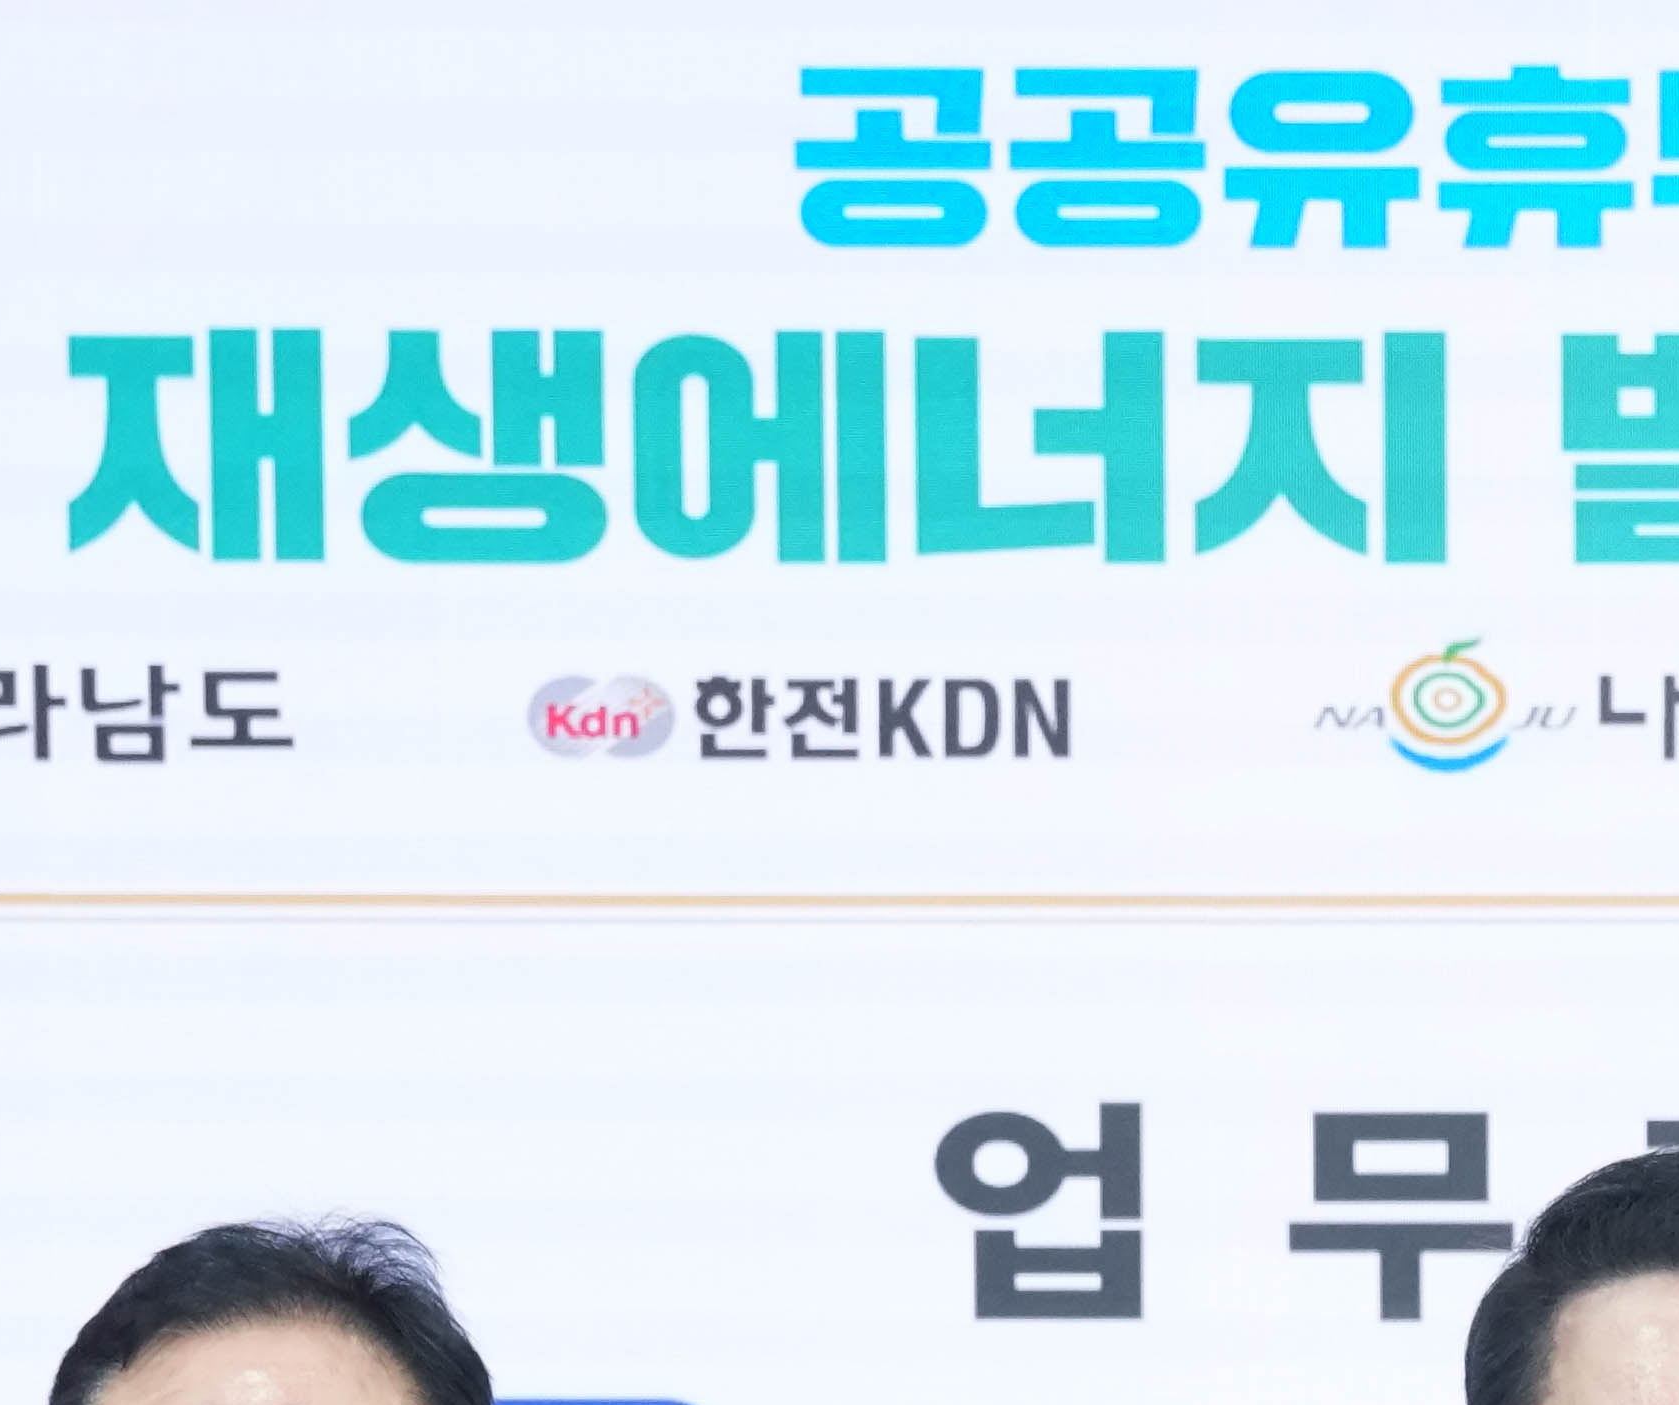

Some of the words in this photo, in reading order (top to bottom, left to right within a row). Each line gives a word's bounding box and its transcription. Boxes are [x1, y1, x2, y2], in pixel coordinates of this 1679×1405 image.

[68, 328, 1447, 564] 재생에너지
[546, 703, 641, 739] Kdn
[694, 675, 1070, 760] 한전KDN
